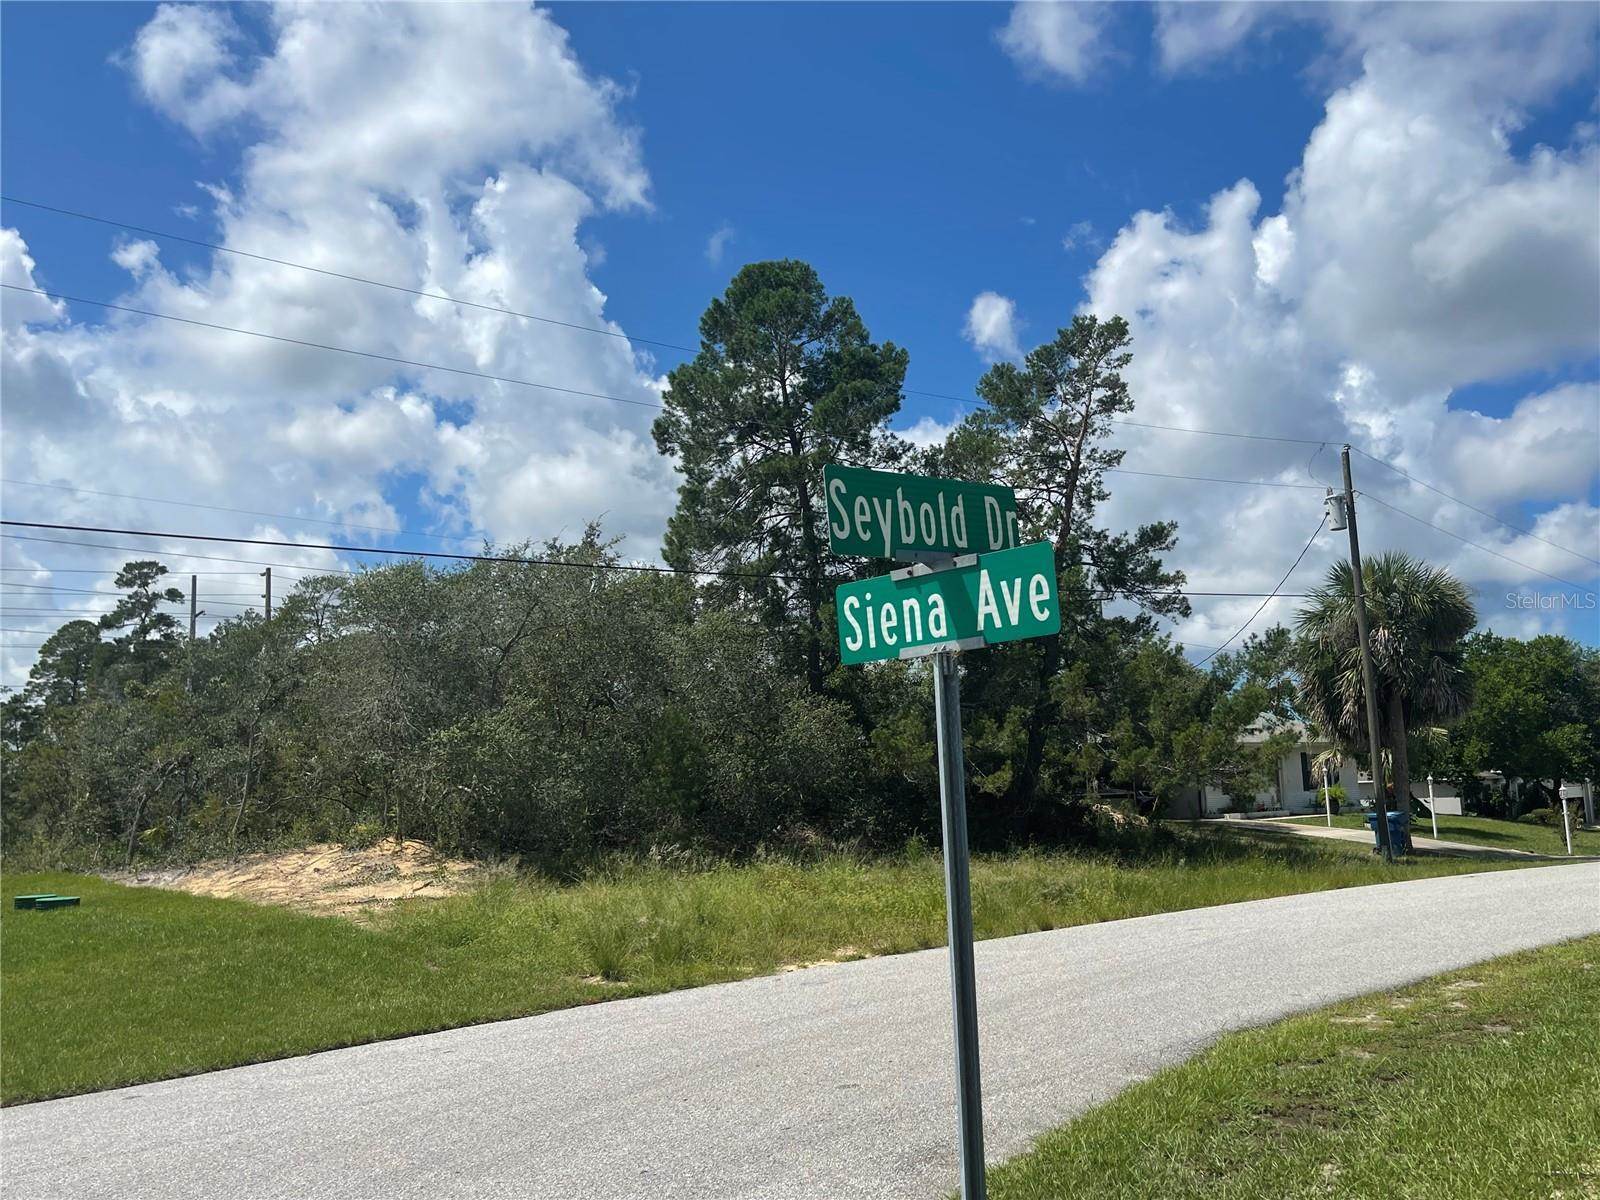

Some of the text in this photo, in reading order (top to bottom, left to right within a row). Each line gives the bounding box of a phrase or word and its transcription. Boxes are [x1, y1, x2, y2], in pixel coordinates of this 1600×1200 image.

[829, 478, 1017, 558] Seybold Dr
[844, 569, 1050, 652] Siena Ave
